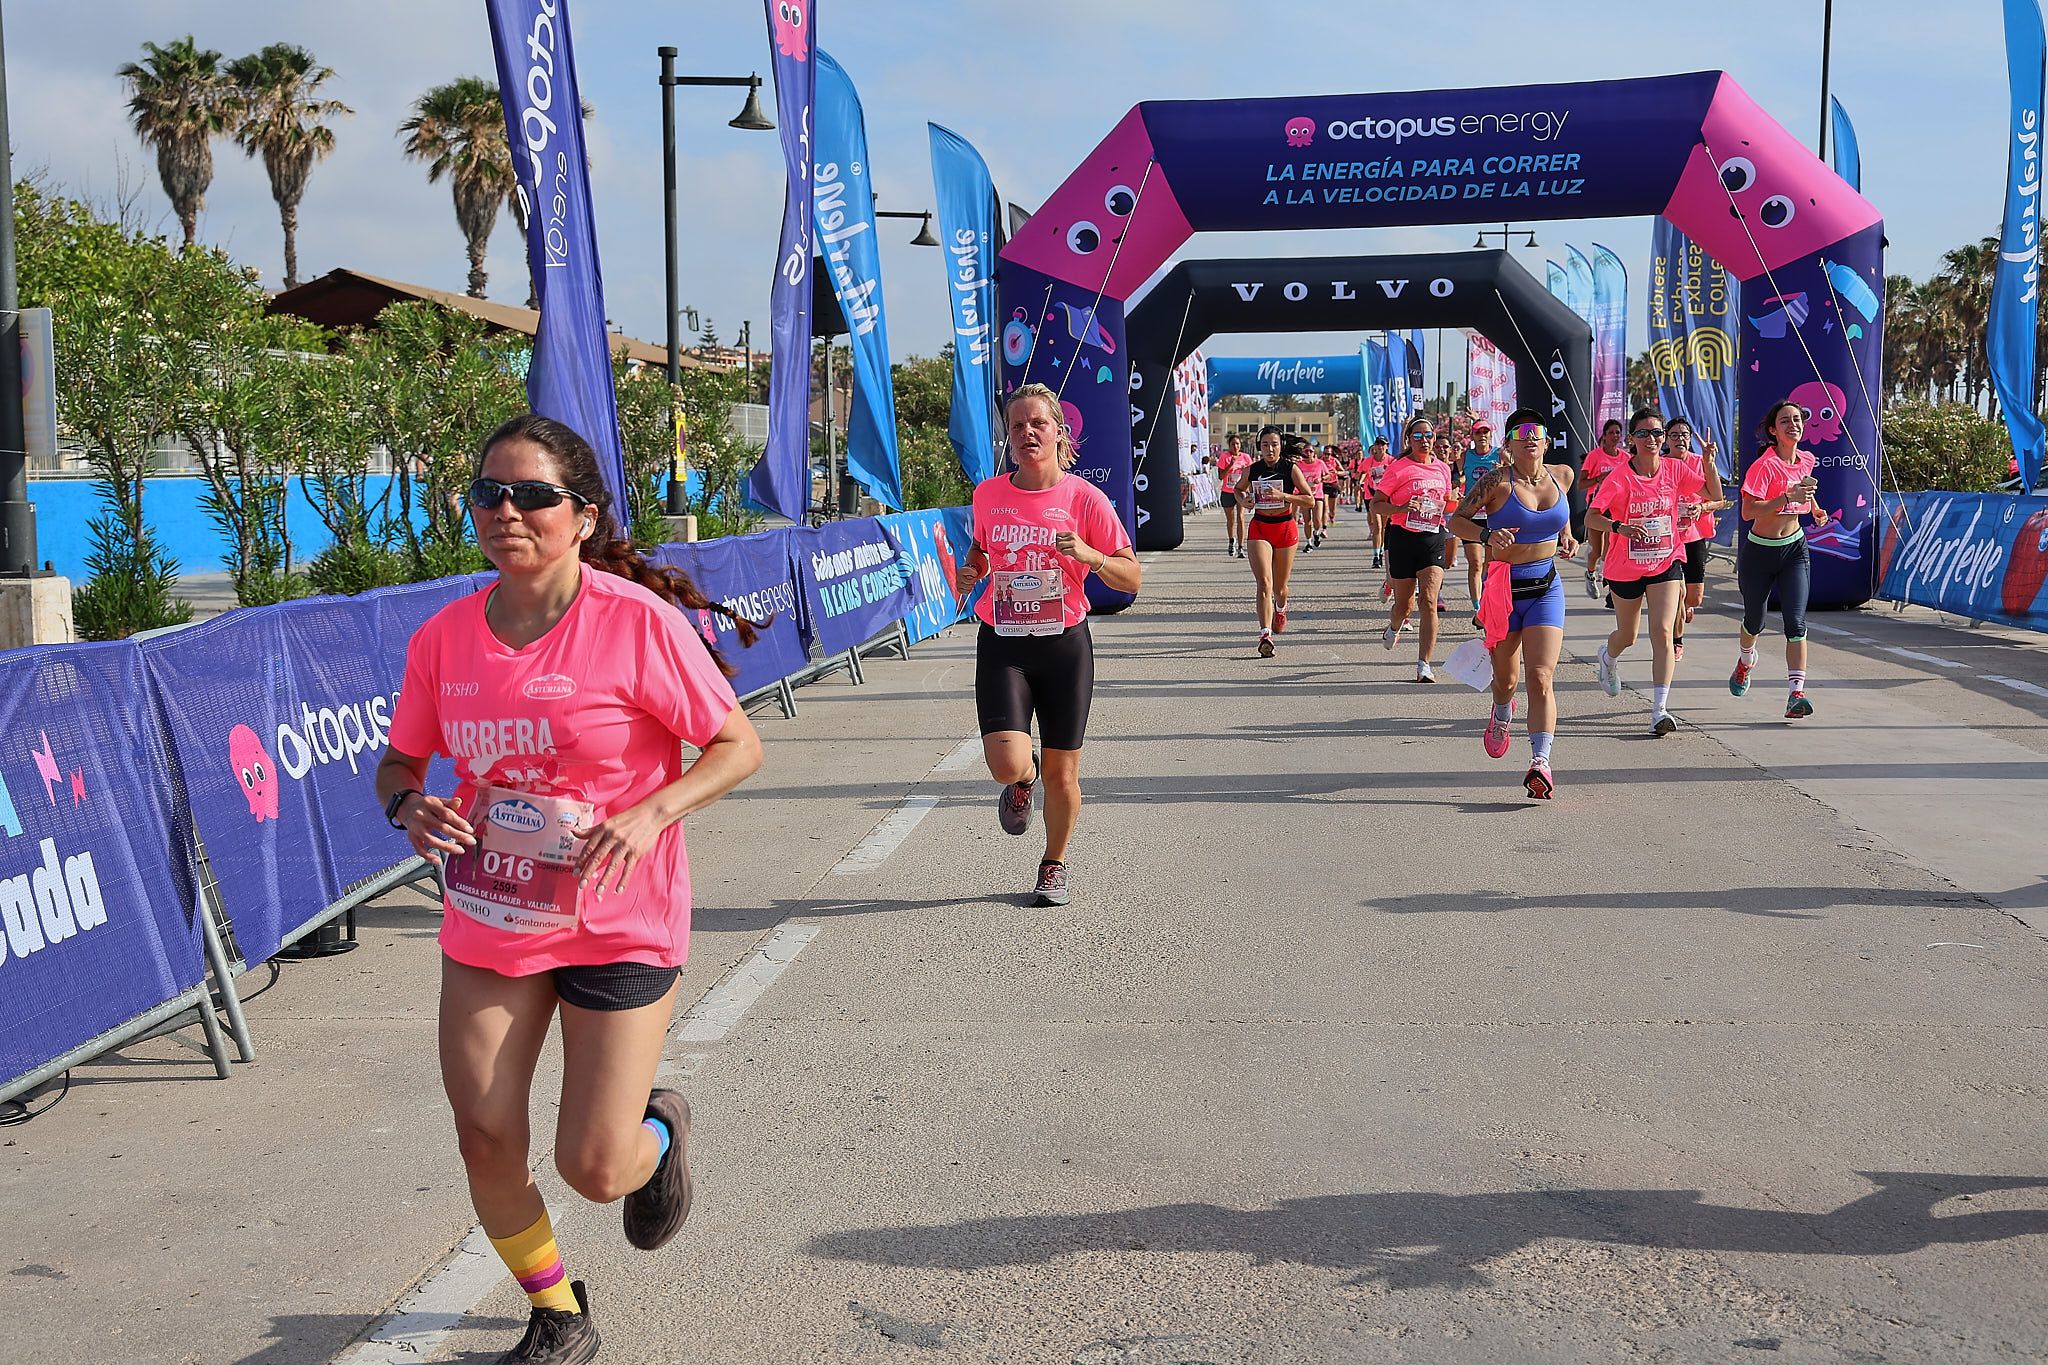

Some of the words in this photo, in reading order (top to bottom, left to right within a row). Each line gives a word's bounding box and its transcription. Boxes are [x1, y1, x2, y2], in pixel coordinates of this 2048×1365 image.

[1327, 115, 1456, 145] octopus
[1460, 110, 1569, 141] energy
[1266, 164, 1295, 182] LA
[1302, 156, 1404, 181] ENERGÍA
[1411, 158, 1476, 178] PARA
[1482, 153, 1581, 176] CORRER
[1263, 189, 1280, 206] A
[1286, 189, 1315, 205] LA
[1323, 185, 1457, 204] VELOCIDAD
[1463, 182, 1495, 200] DE
[1500, 181, 1531, 198] LA
[1537, 178, 1586, 197] LUZ
[1231, 278, 1455, 302] VOLVO
[1257, 359, 1325, 391] Marlene
[1130, 371, 1151, 529] VOLVO
[991, 507, 1019, 515] OYSHO
[991, 524, 1057, 547] CARRERA
[1644, 536, 1661, 544] 016
[1896, 497, 2003, 606] Marlene
[1014, 601, 1041, 613] 016
[443, 718, 558, 758] CARRERA
[491, 808, 542, 829] ASTURIANA
[483, 851, 534, 882] 016
[455, 882, 480, 897] CARRERA
[480, 890, 489, 899] DE
[489, 891, 498, 901] LA
[498, 893, 521, 907] MUJER
[527, 900, 561, 913] VALENCIA
[492, 880, 518, 895] 2595
[514, 915, 559, 929] Santander
